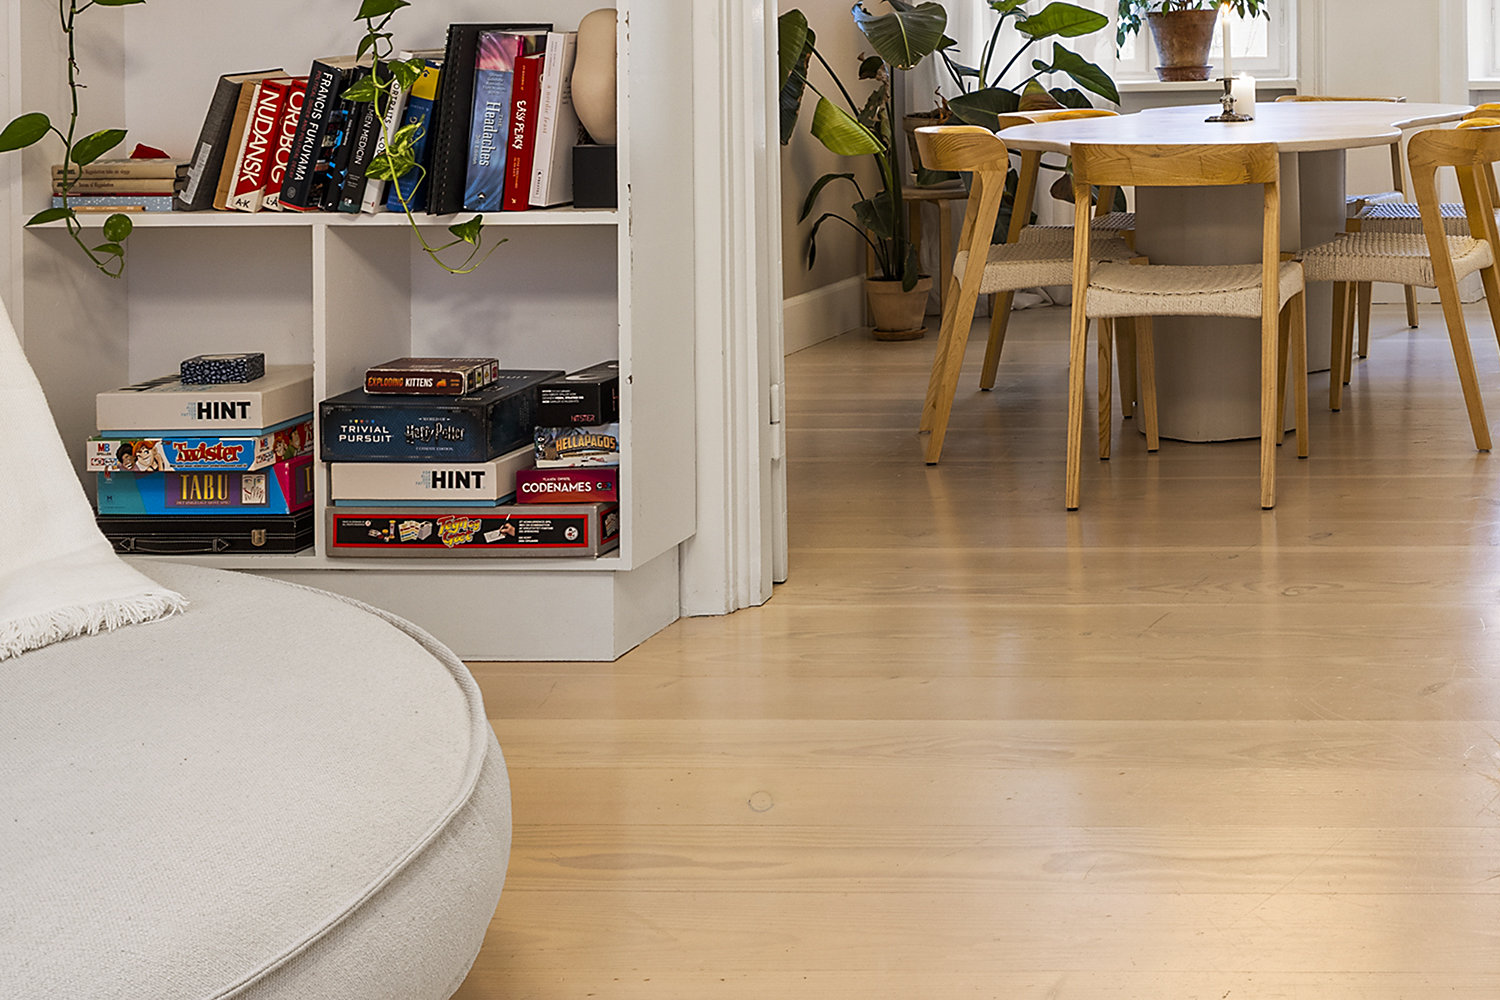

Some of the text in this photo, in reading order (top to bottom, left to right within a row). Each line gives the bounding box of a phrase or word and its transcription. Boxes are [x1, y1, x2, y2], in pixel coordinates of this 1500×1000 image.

[294, 72, 333, 181] FRANCIS FUKUYAMA
[479, 101, 501, 167] Headaches
[512, 100, 527, 150] EASY PERCY
[239, 89, 280, 187] NUDANSK
[270, 91, 306, 183] ORDBOG
[354, 128, 372, 164] MEDICIN
[368, 377, 433, 388] EXPLODING KITTENS
[197, 402, 251, 420] HINT
[338, 434, 392, 443] PURSUIT
[340, 425, 390, 433] TRIVIAL
[405, 422, 466, 445] Harry Potter
[173, 441, 244, 463] Twister
[555, 434, 617, 452] HELLAPAGOS
[180, 474, 230, 500] TABU
[431, 470, 486, 489] HINT
[522, 481, 592, 493] CODENAMES
[437, 516, 468, 533] Tegn
